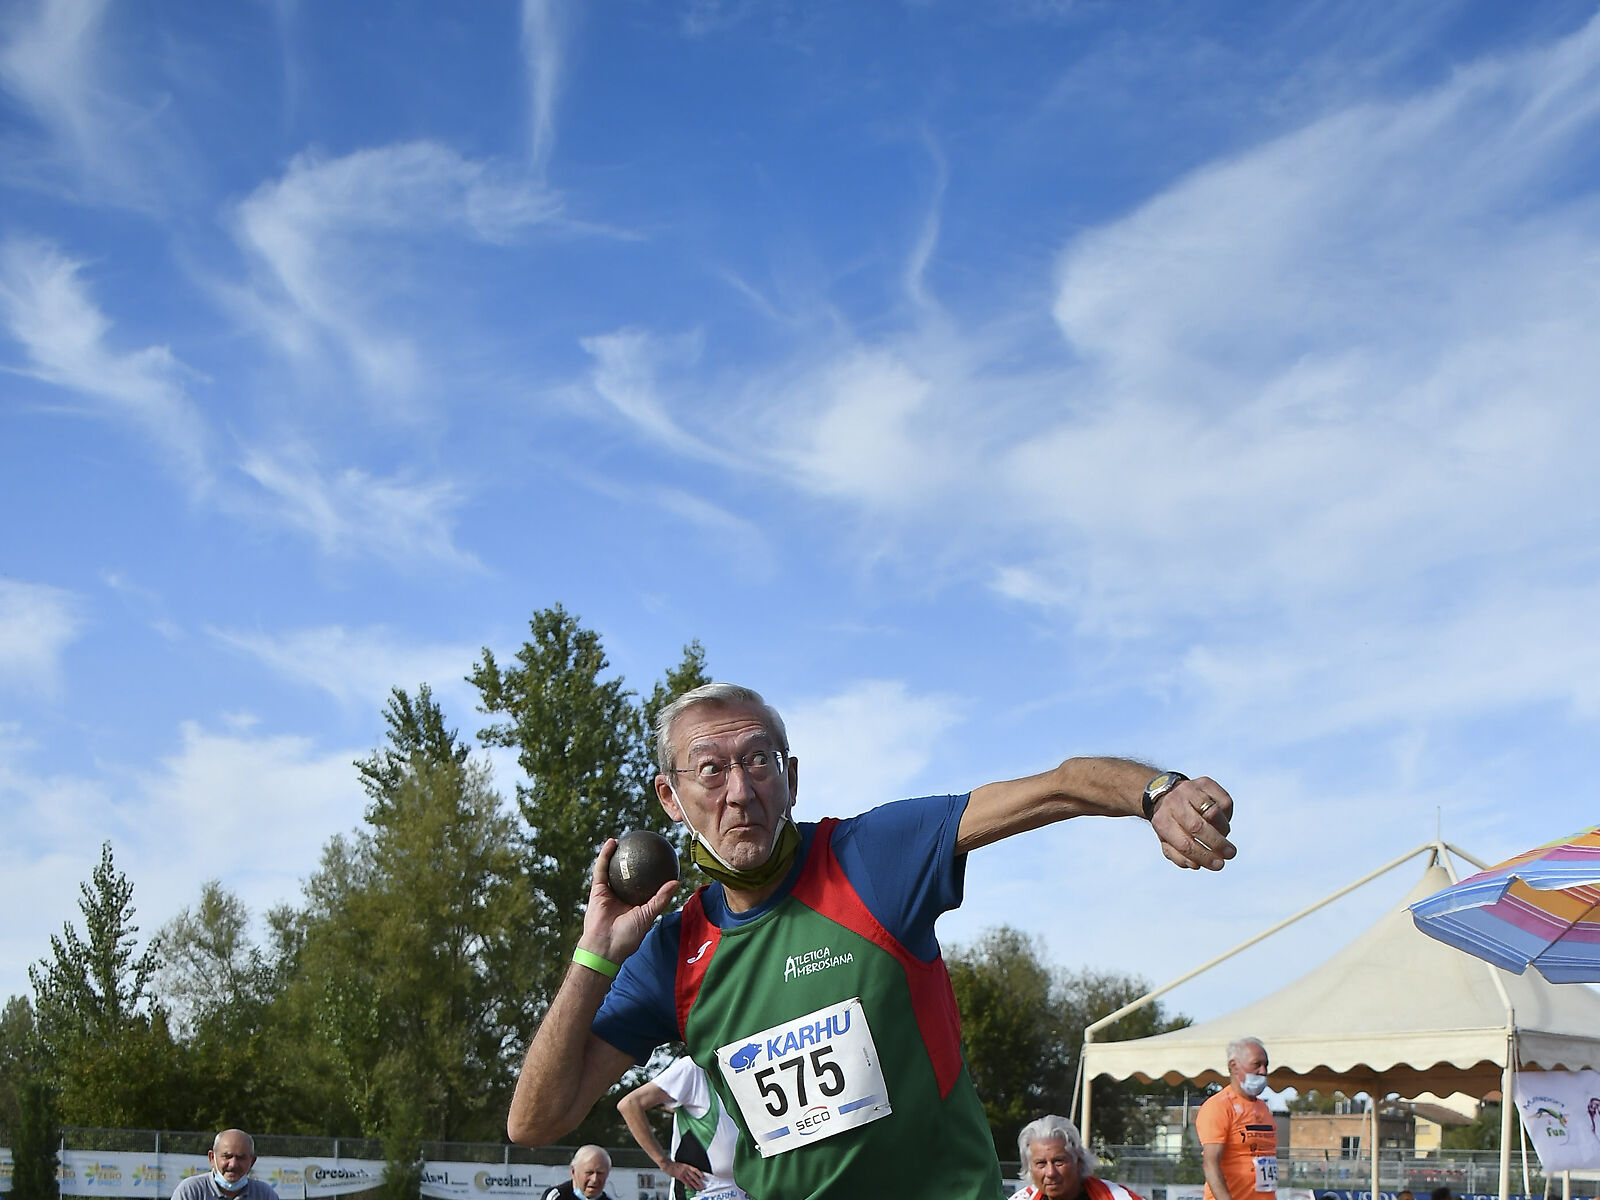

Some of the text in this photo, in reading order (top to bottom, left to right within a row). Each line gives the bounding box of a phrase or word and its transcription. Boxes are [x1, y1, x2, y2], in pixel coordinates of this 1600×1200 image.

[784, 946, 831, 980] ATLETICA
[784, 952, 854, 982] AMBROSIANA
[766, 1009, 851, 1061] KARHU
[754, 1045, 846, 1118] 575
[795, 1110, 831, 1131] SECO
